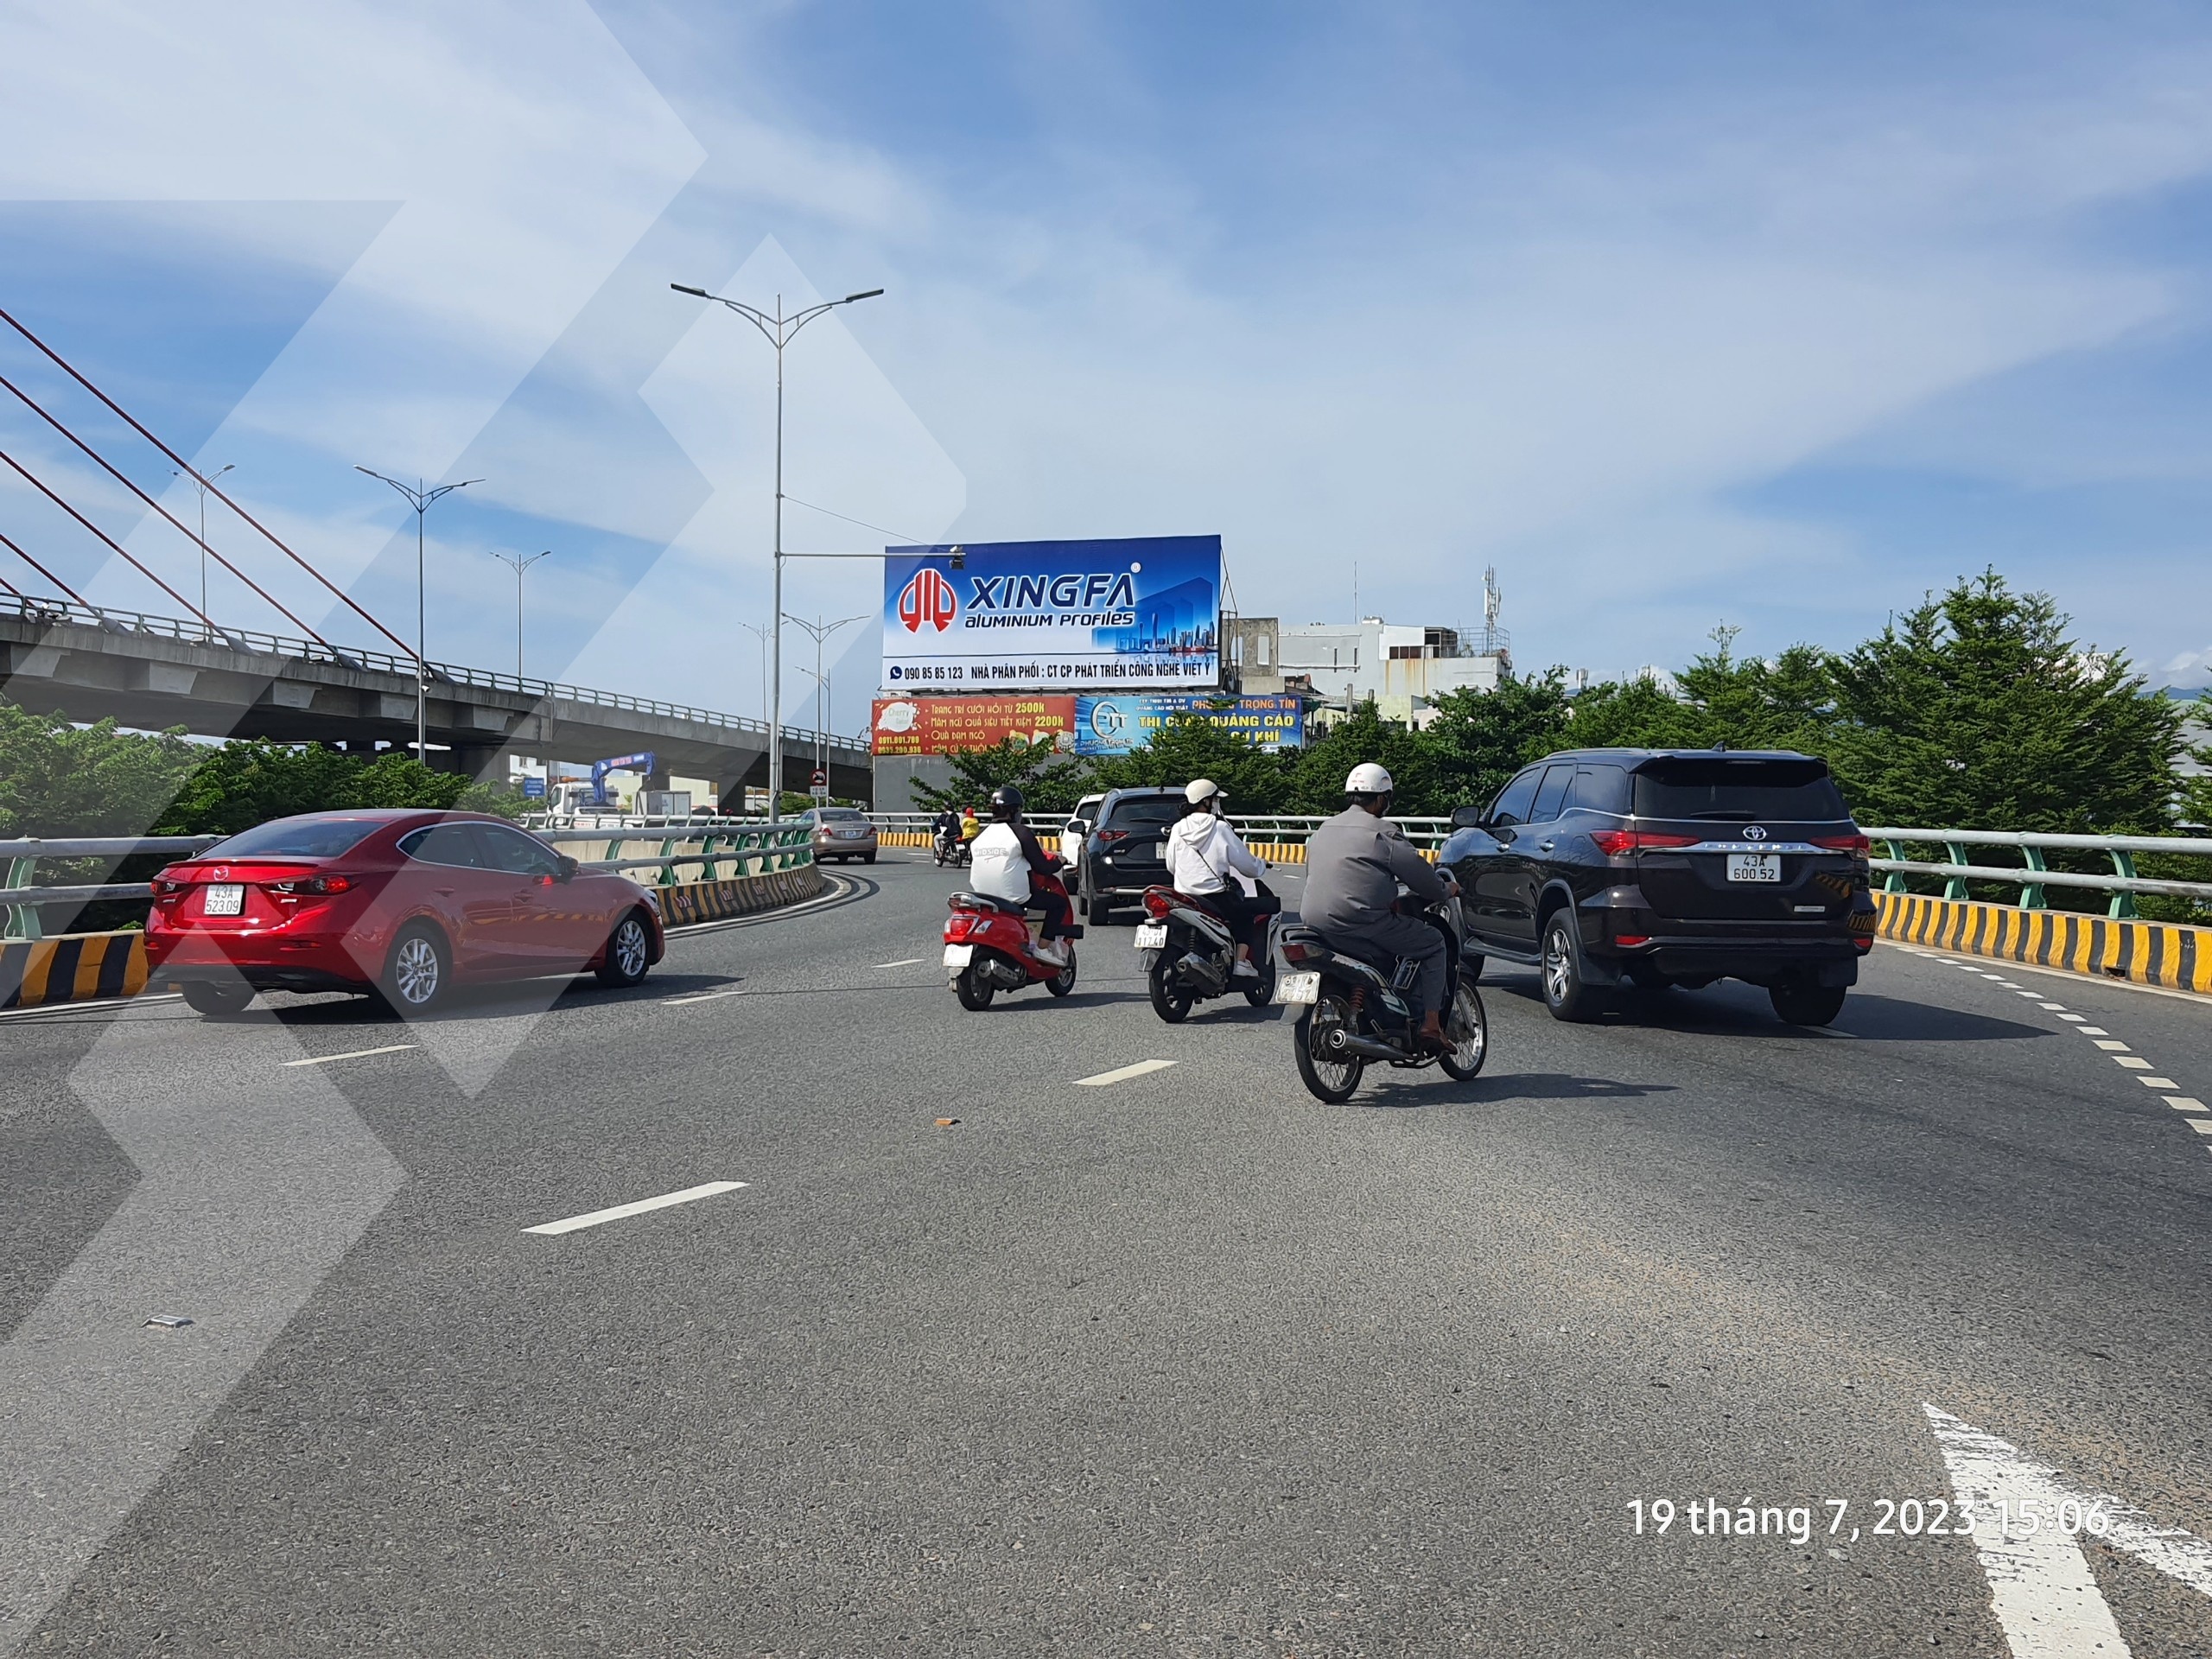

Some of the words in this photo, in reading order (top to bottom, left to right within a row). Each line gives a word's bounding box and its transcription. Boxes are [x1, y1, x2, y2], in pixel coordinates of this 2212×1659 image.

[965, 574, 1135, 611] XINGFA
[905, 667, 920, 679] 090
[922, 667, 932, 679] 85
[935, 667, 945, 679] 85
[948, 666, 963, 679] 123
[971, 664, 989, 679] NHÀ
[992, 663, 1016, 679] PHÂN
[1019, 660, 1039, 678] PHỐI
[1047, 664, 1058, 677] CT
[1060, 664, 1072, 677] CP
[1075, 662, 1097, 677] PHÁT
[1097, 658, 1126, 677] TRIỂN
[1128, 661, 1154, 677] CÔNG
[1156, 660, 1180, 677] NGHỆ
[1183, 660, 1202, 677] VIỆT
[931, 704, 952, 714] TRANG
[954, 703, 964, 714] TRÍ
[967, 703, 985, 714] CƯỚI
[988, 702, 1001, 714] HỎI
[1004, 703, 1013, 714] TỪ
[1239, 699, 1274, 710] TRỌNG
[1279, 697, 1295, 709] TÍN
[965, 715, 982, 727] QUẢ
[1000, 715, 1014, 726] TIẾT
[1138, 715, 1161, 728] THI
[1210, 713, 1260, 727] QUẢNG
[1264, 714, 1294, 727] CÁO
[931, 730, 950, 741] QUÀ
[1255, 728, 1280, 741] KHÍ
[1744, 855, 1765, 868] 43A
[1733, 868, 1775, 880] 600.52
[214, 885, 233, 899] 43A
[206, 900, 239, 913] 523.09
